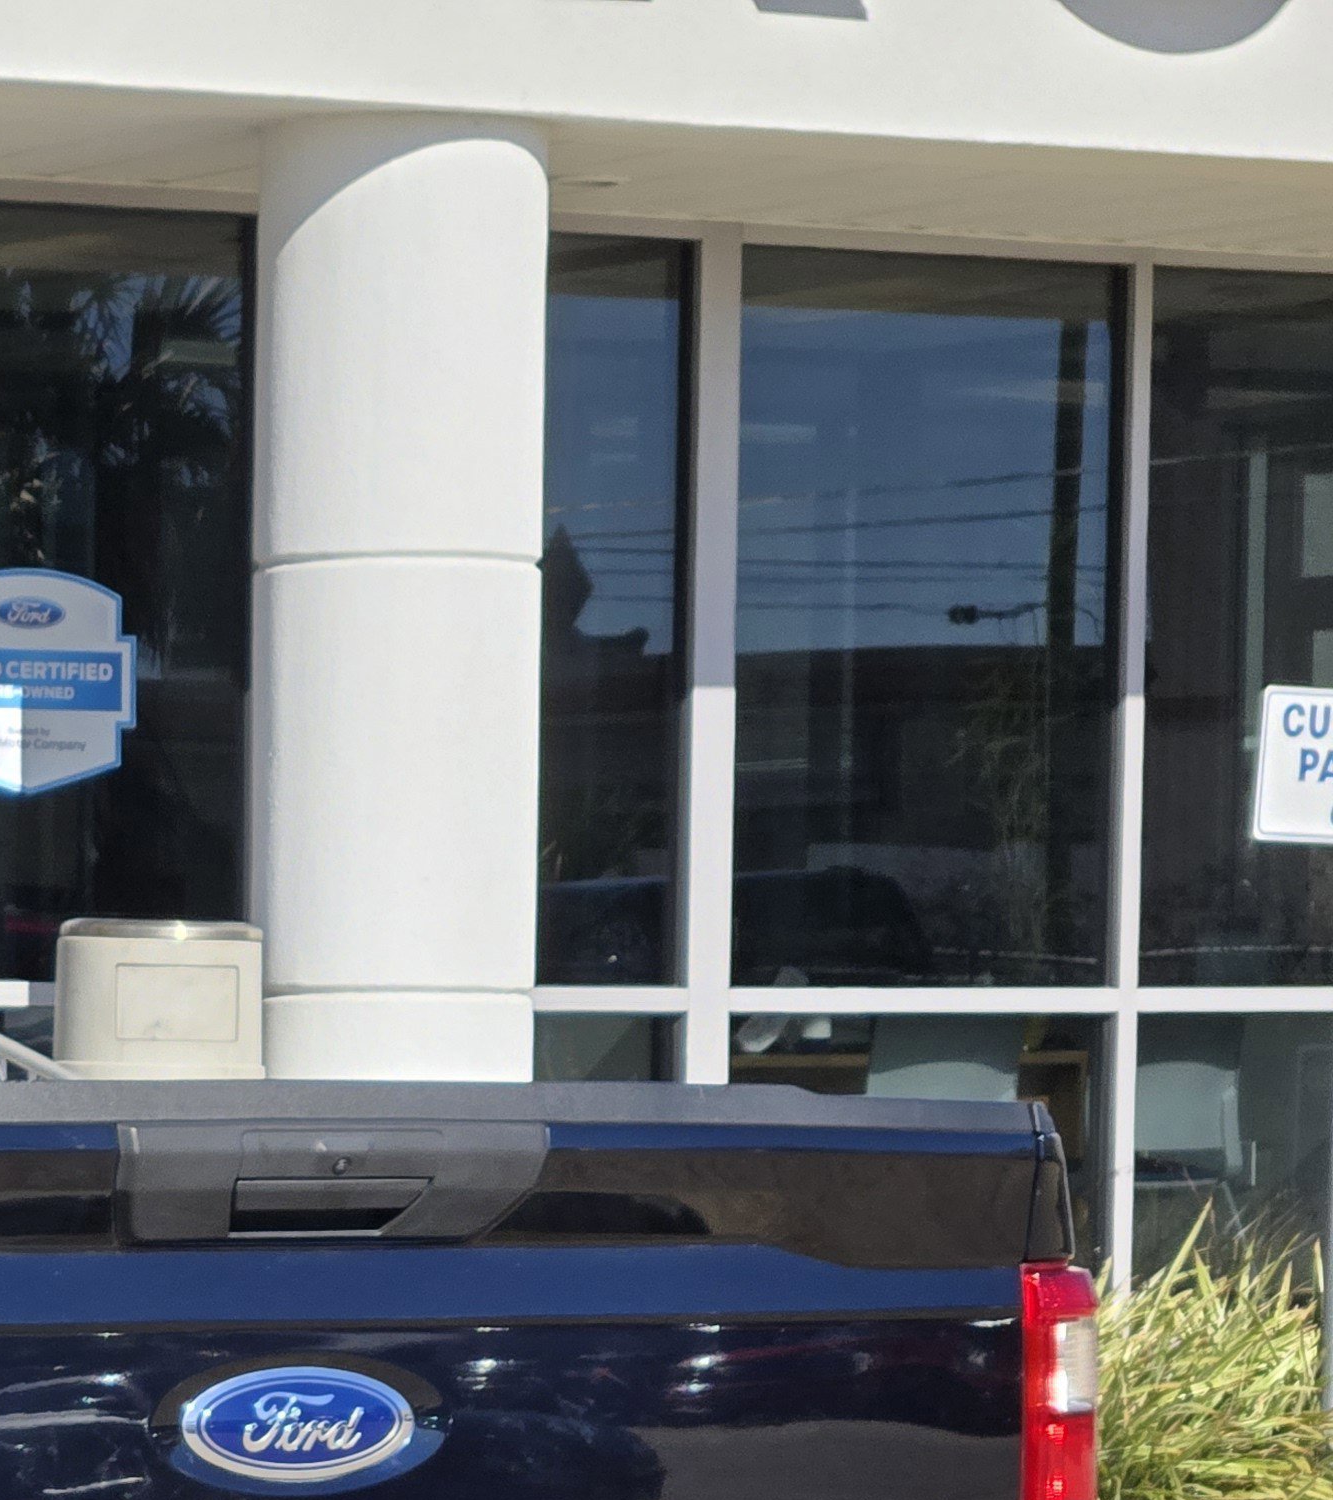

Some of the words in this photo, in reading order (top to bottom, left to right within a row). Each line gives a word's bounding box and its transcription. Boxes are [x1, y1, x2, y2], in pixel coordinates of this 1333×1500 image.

[5, 660, 114, 681] CERTIFIED
[33, 739, 86, 752] Company
[243, 1391, 364, 1452] Ford
